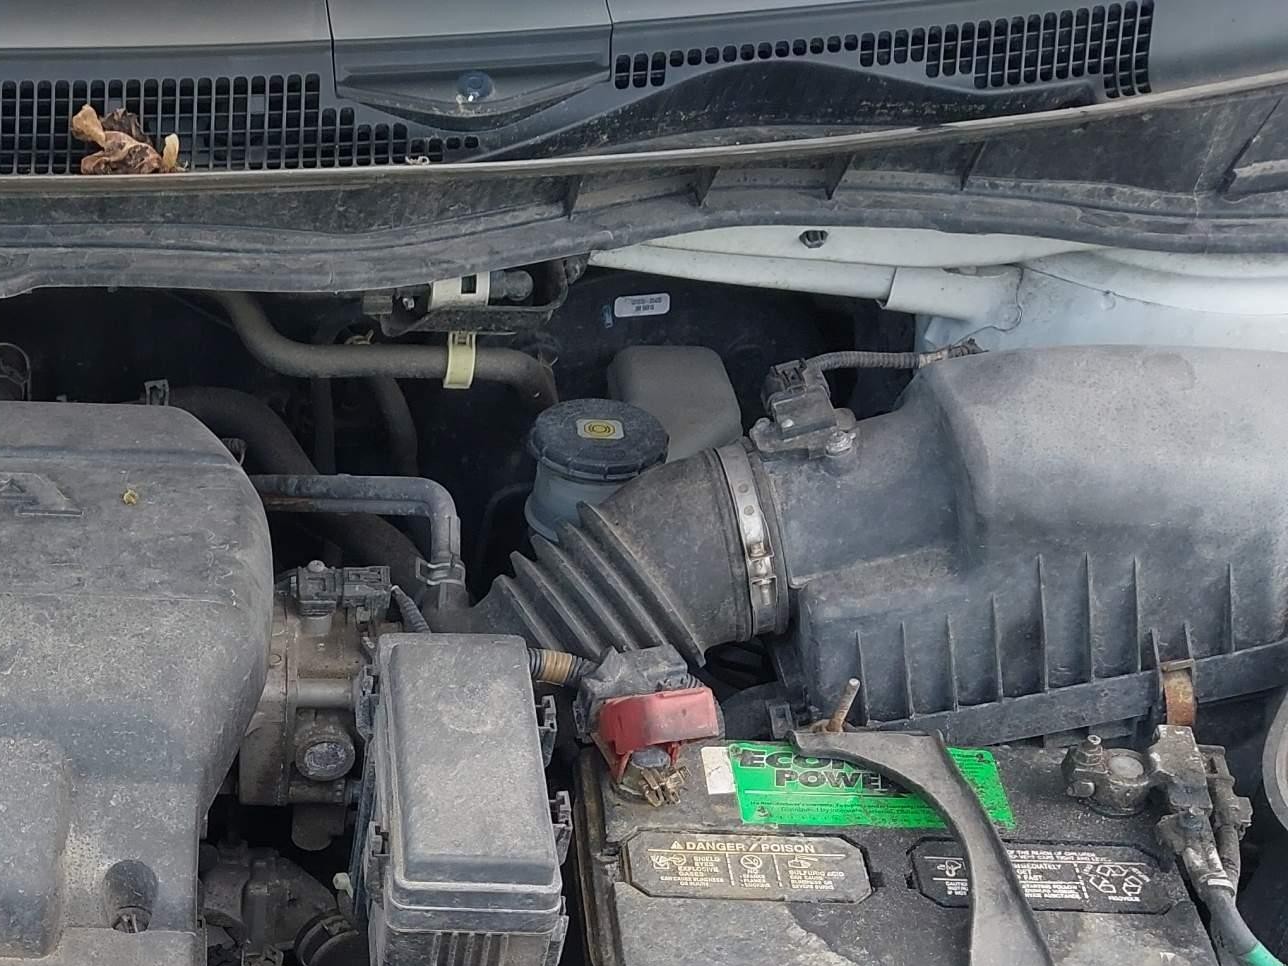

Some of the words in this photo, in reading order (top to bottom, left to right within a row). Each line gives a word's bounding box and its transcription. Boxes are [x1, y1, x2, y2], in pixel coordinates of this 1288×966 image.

[739, 749, 854, 769] ECO
[774, 768, 888, 791] POWE
[685, 841, 746, 852] DANGER
[761, 843, 816, 853] POISON
